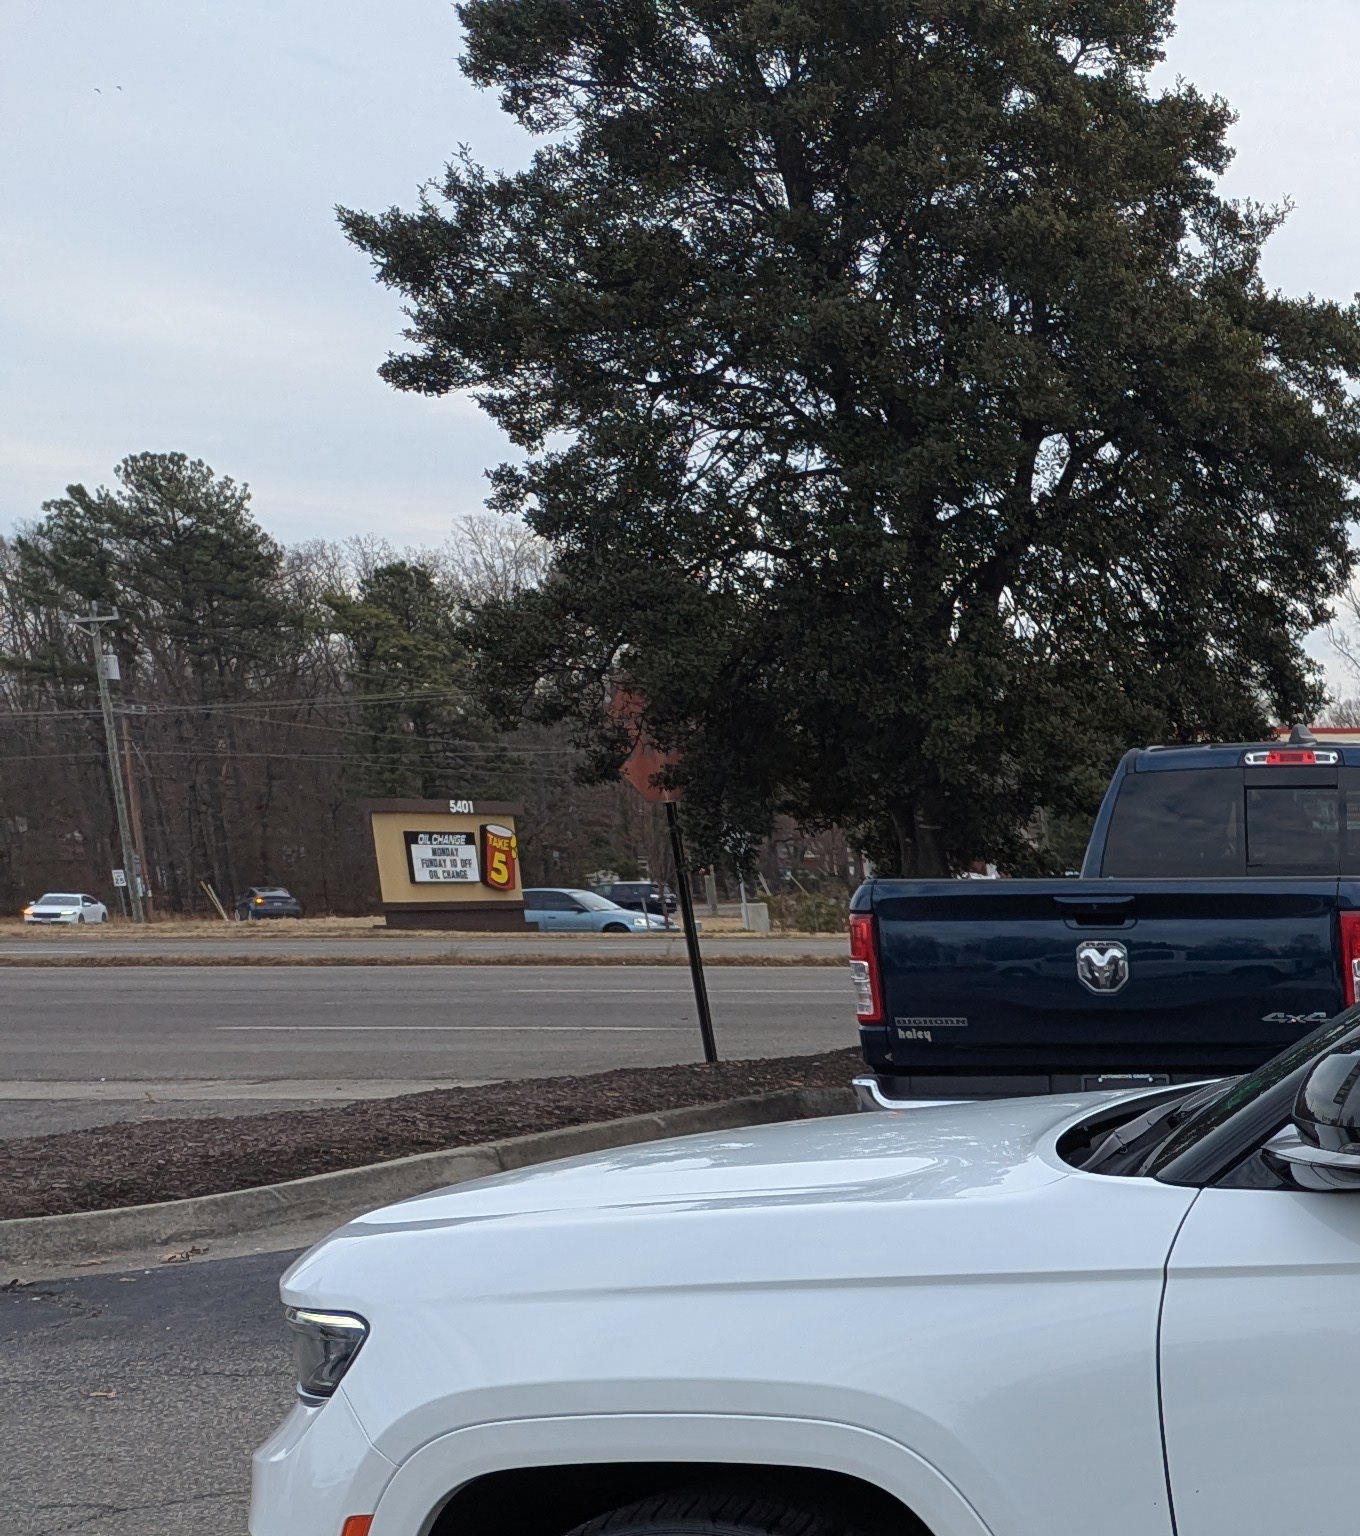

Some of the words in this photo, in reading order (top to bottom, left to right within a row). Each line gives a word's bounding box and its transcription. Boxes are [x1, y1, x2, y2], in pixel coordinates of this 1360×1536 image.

[449, 800, 474, 813] 5401
[417, 833, 431, 845] OIL
[431, 834, 466, 845] CHANGE
[487, 833, 510, 850] TAKE
[431, 847, 459, 857] MONDAY
[421, 858, 447, 868] FUNDAY
[450, 859, 458, 868] 10
[460, 858, 473, 868] OFF
[490, 851, 509, 884] 5
[429, 870, 440, 880] OIL
[441, 869, 469, 880] CHANGE
[1261, 1012, 1332, 1024] 4x4
[897, 1028, 932, 1042] haley
